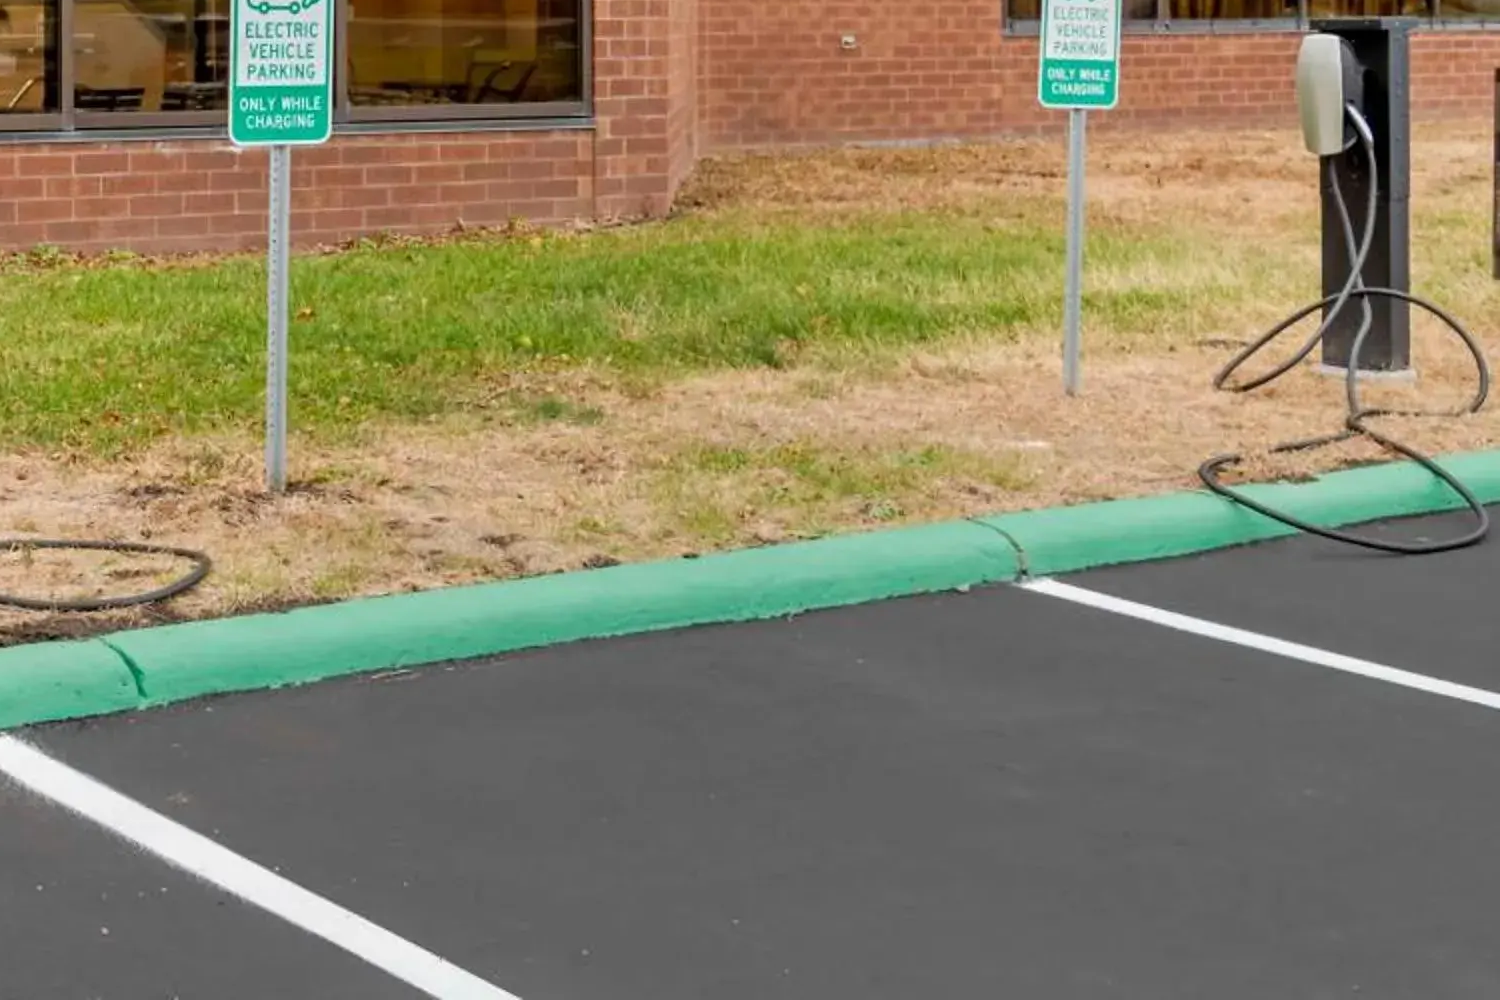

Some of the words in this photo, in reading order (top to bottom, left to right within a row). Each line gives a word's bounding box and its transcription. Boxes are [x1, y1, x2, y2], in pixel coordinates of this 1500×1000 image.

[245, 22, 319, 38] ELECTRIC
[250, 43, 315, 59] VEHICLE
[247, 64, 315, 80] PARKING
[240, 97, 276, 111] ONLY
[282, 96, 322, 111] WHILE
[246, 115, 315, 129] CHARGING
